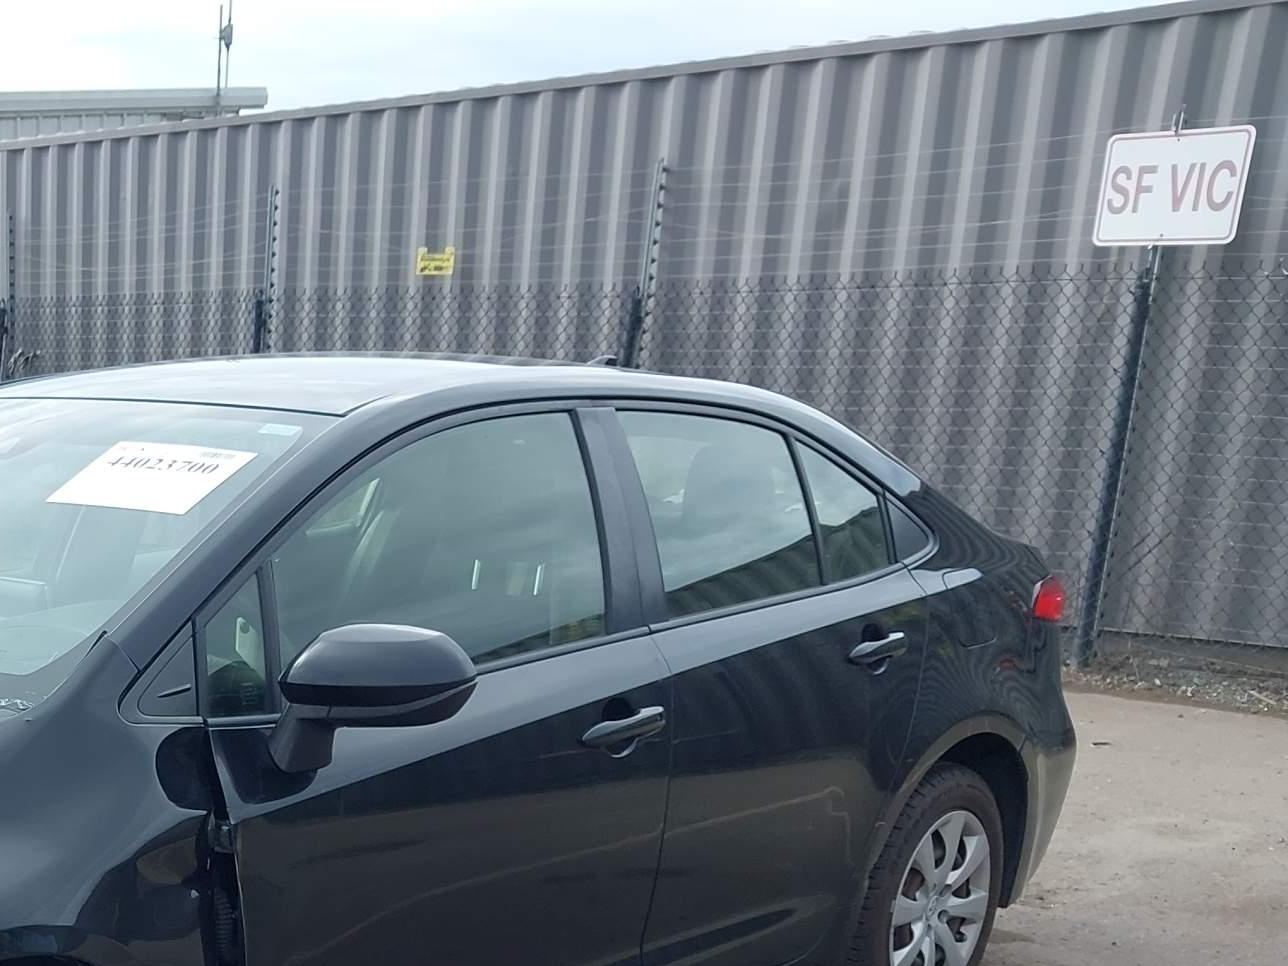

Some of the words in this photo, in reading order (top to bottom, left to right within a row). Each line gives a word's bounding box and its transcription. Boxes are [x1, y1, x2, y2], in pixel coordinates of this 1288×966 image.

[1107, 164, 1160, 215] SF
[1171, 159, 1238, 213] VIC
[107, 455, 220, 474] 44023700
